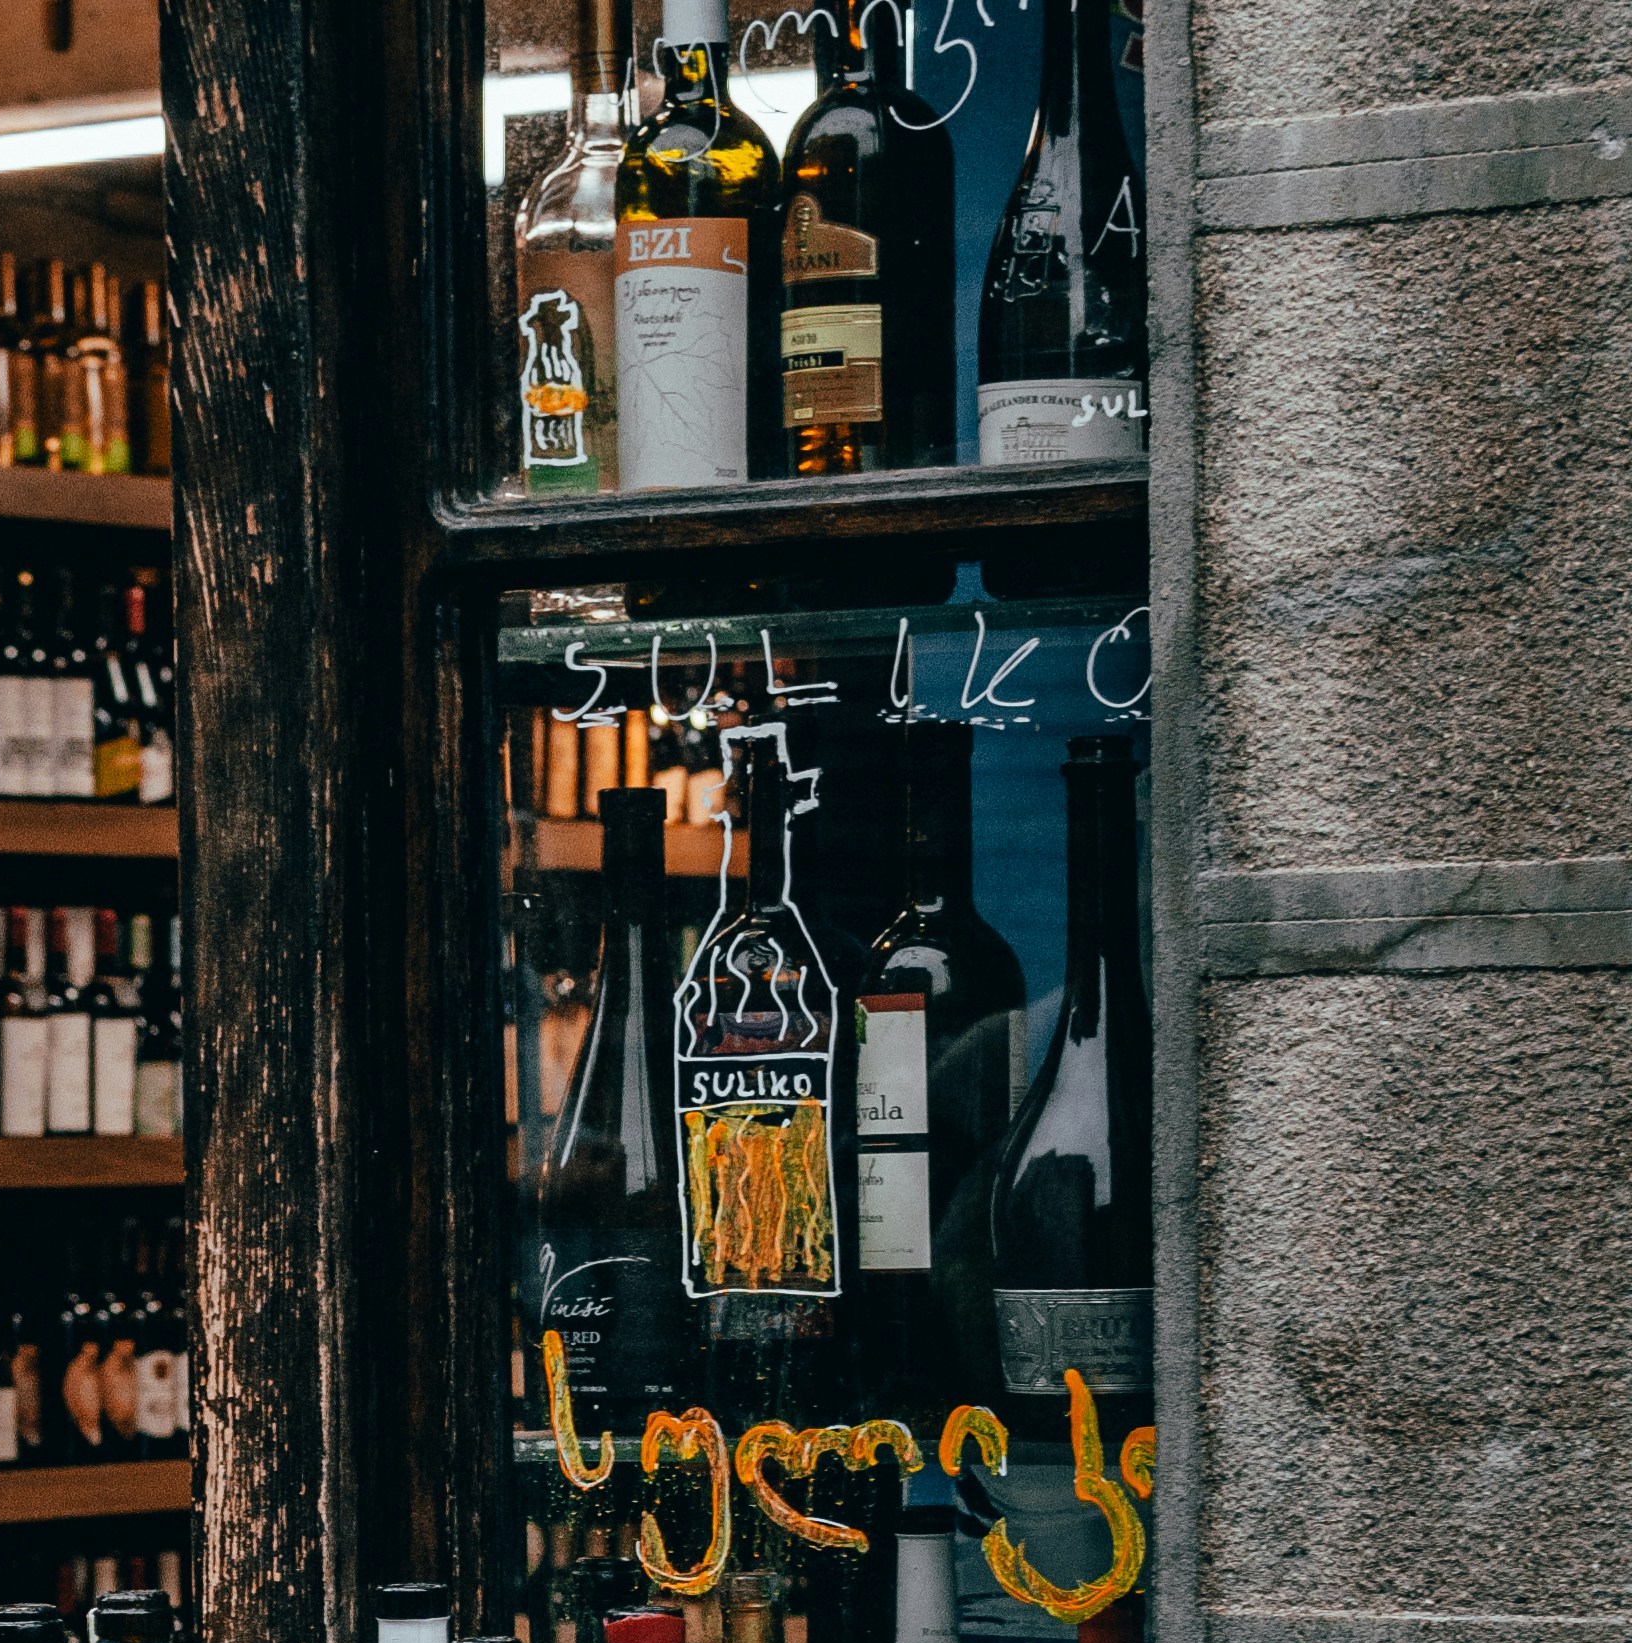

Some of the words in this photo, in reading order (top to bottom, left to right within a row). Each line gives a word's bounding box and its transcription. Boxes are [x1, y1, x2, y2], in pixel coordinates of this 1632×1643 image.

[627, 226, 694, 263] EZI
[690, 1069, 813, 1105] SULIKO
[571, 1331, 602, 1345] RED
